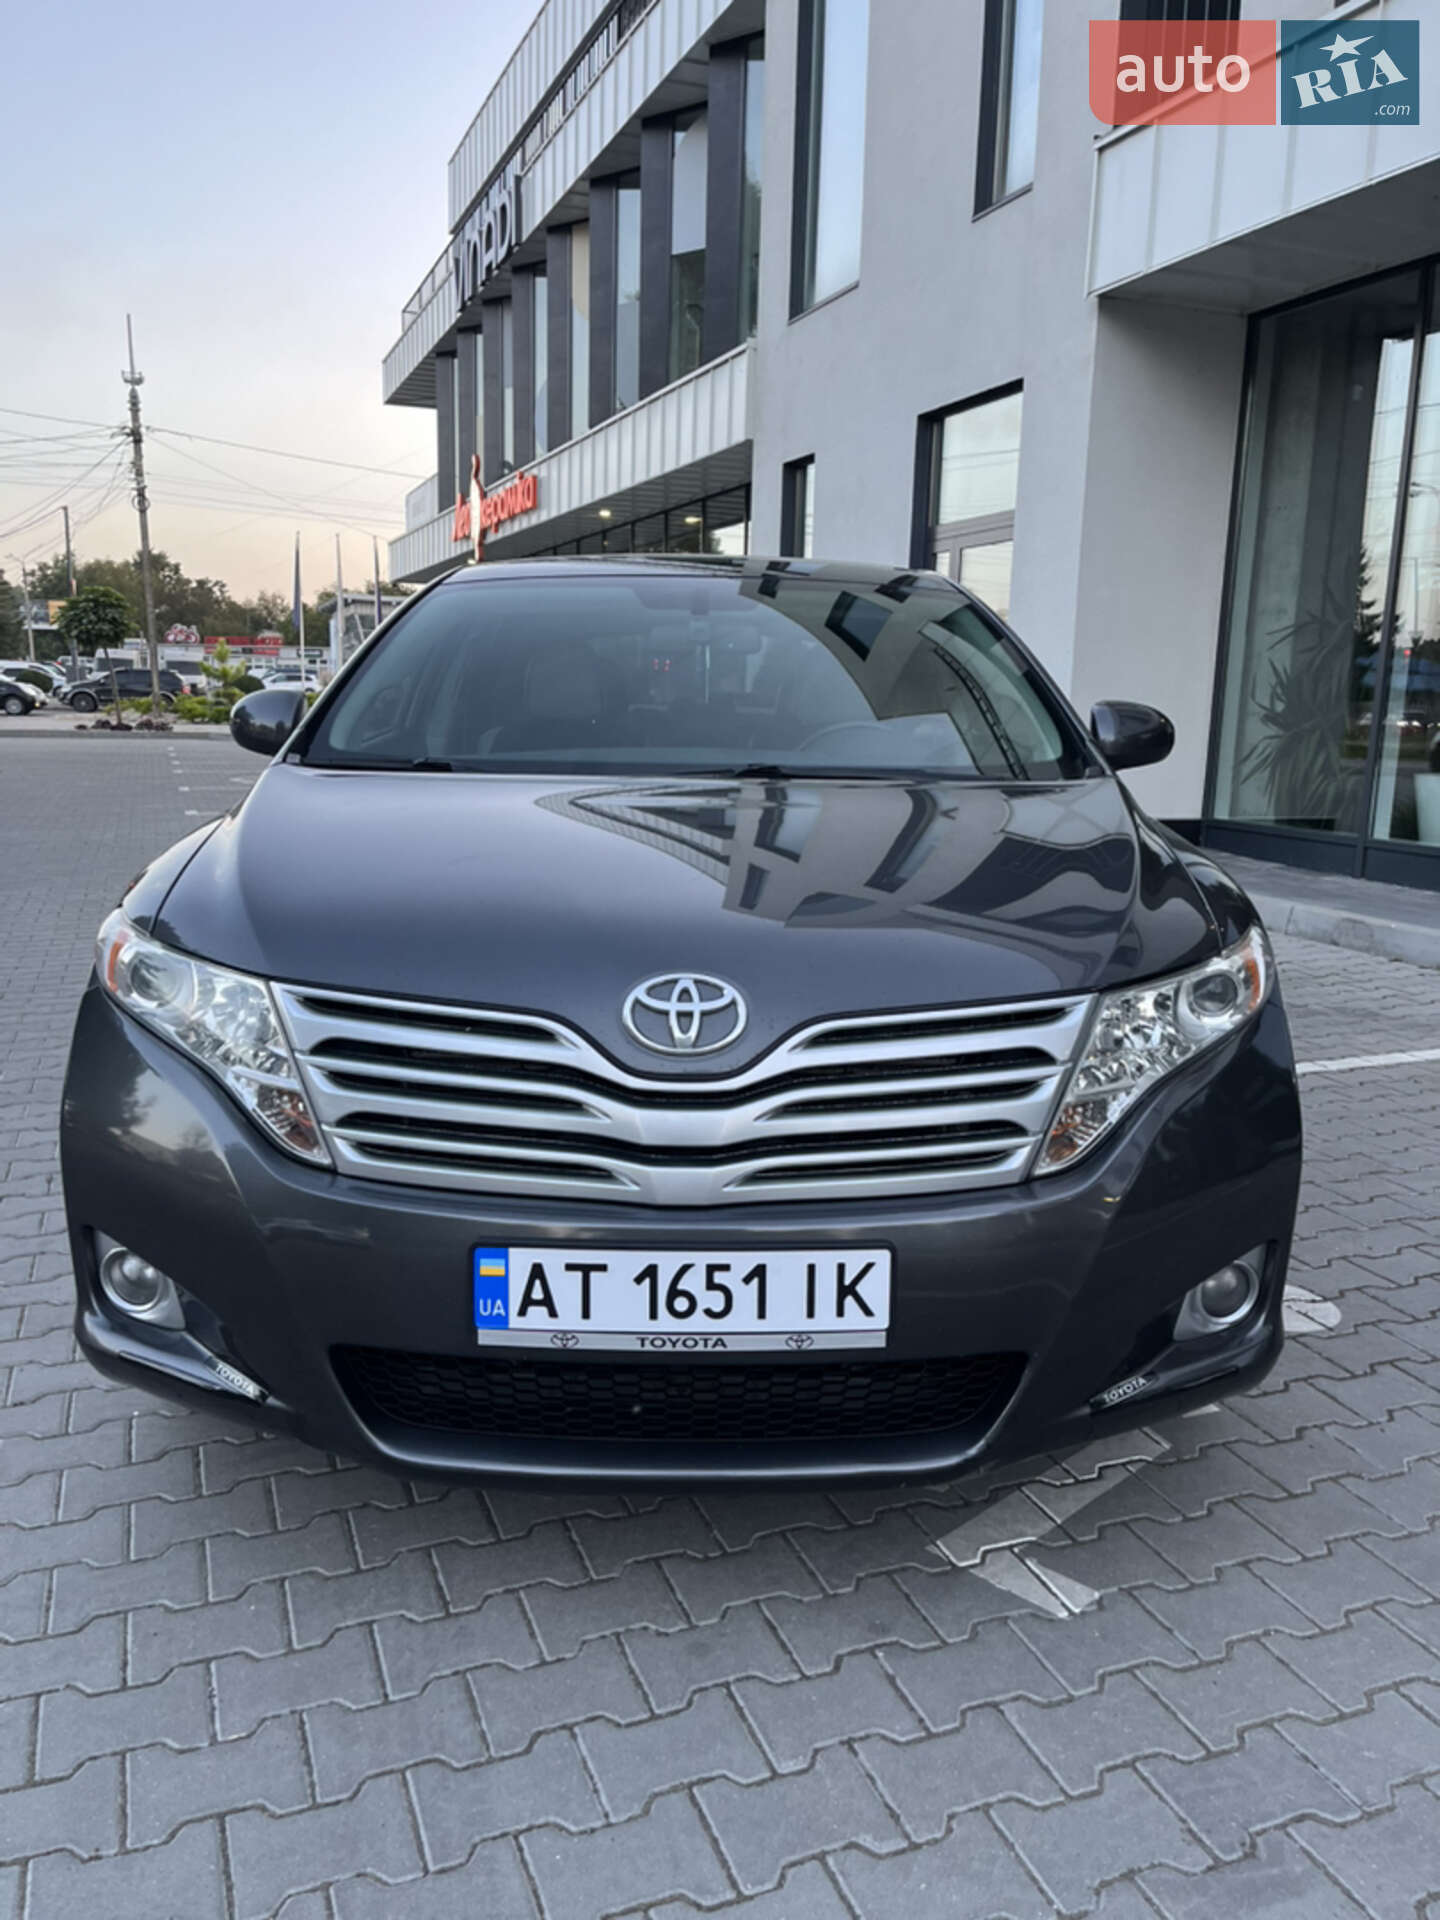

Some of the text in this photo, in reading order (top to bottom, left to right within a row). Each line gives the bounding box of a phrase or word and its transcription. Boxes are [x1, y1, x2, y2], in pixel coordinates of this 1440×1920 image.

[517, 1262, 877, 1321] AT 1651 IK
[479, 1299, 506, 1317] UA
[636, 1336, 728, 1350] TOYOTA
